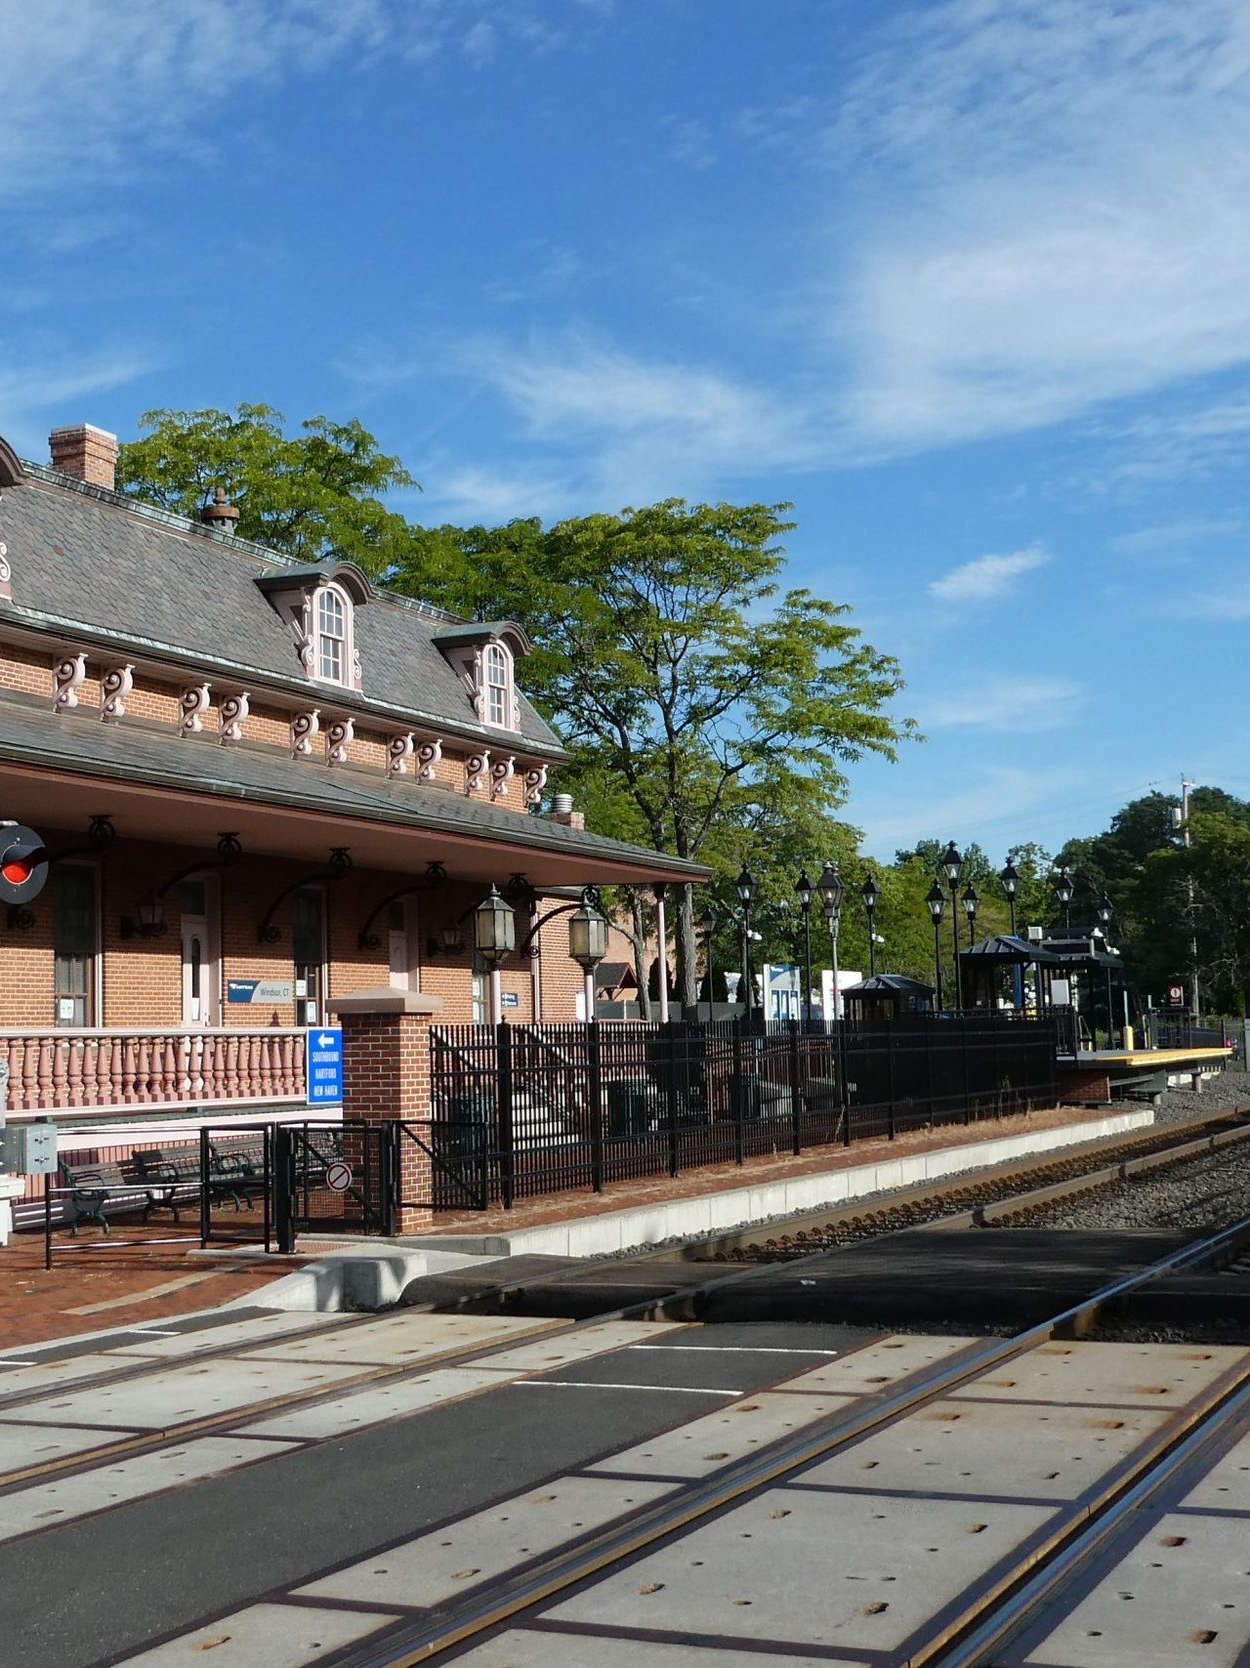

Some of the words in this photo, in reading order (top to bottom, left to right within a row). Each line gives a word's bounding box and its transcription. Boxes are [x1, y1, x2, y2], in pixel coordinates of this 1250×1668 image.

[312, 1051, 339, 1062] SOUTHBOUND
[315, 1068, 336, 1079] HARTFORD
[314, 1085, 323, 1096] NEW
[324, 1085, 338, 1096] HAVEN
